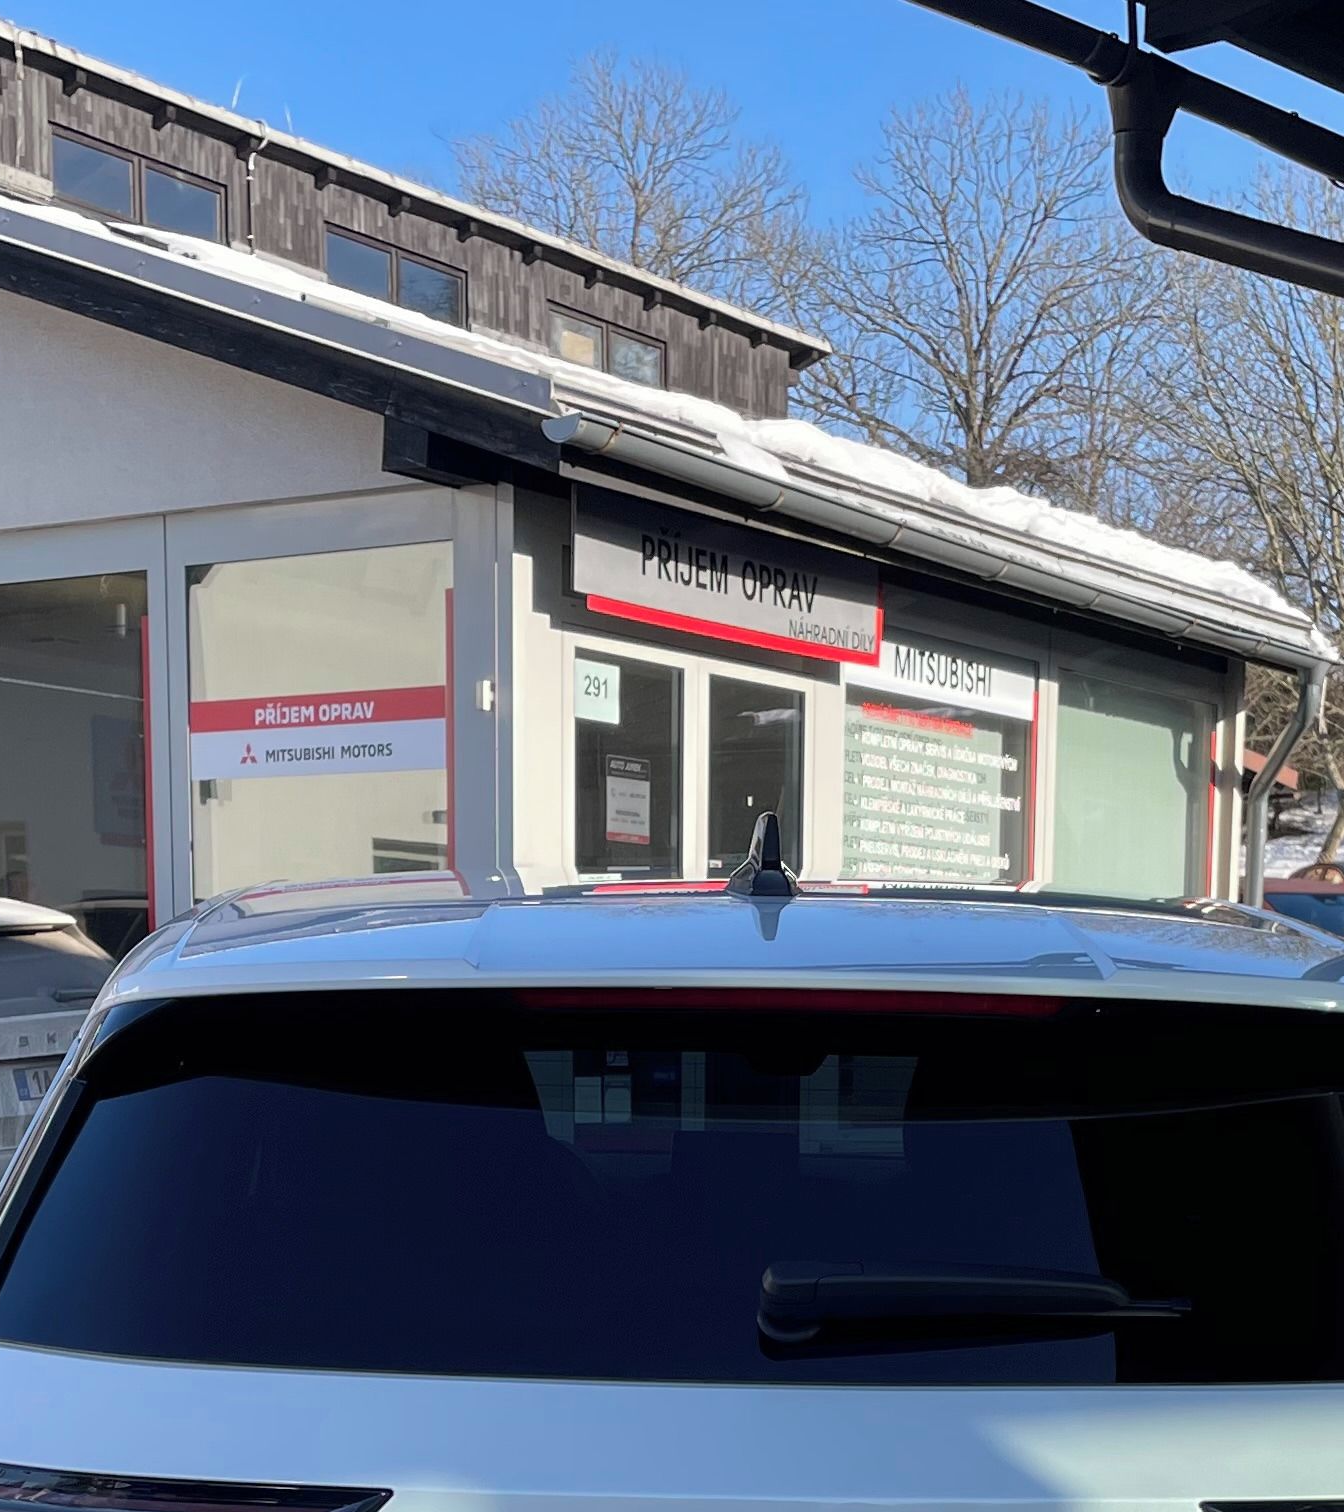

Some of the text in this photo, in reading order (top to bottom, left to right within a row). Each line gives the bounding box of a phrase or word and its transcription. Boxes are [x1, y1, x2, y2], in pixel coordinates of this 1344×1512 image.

[641, 527, 818, 614] PŘÍJEM OPRAV
[788, 616, 875, 652] NÁHRADNÍ DÍLY
[894, 645, 992, 697] MITSUBISHI
[584, 675, 608, 699] 291
[254, 701, 375, 726] PŘÍJEM OPRAV
[265, 743, 393, 763] MITSUBISHI MOTORS
